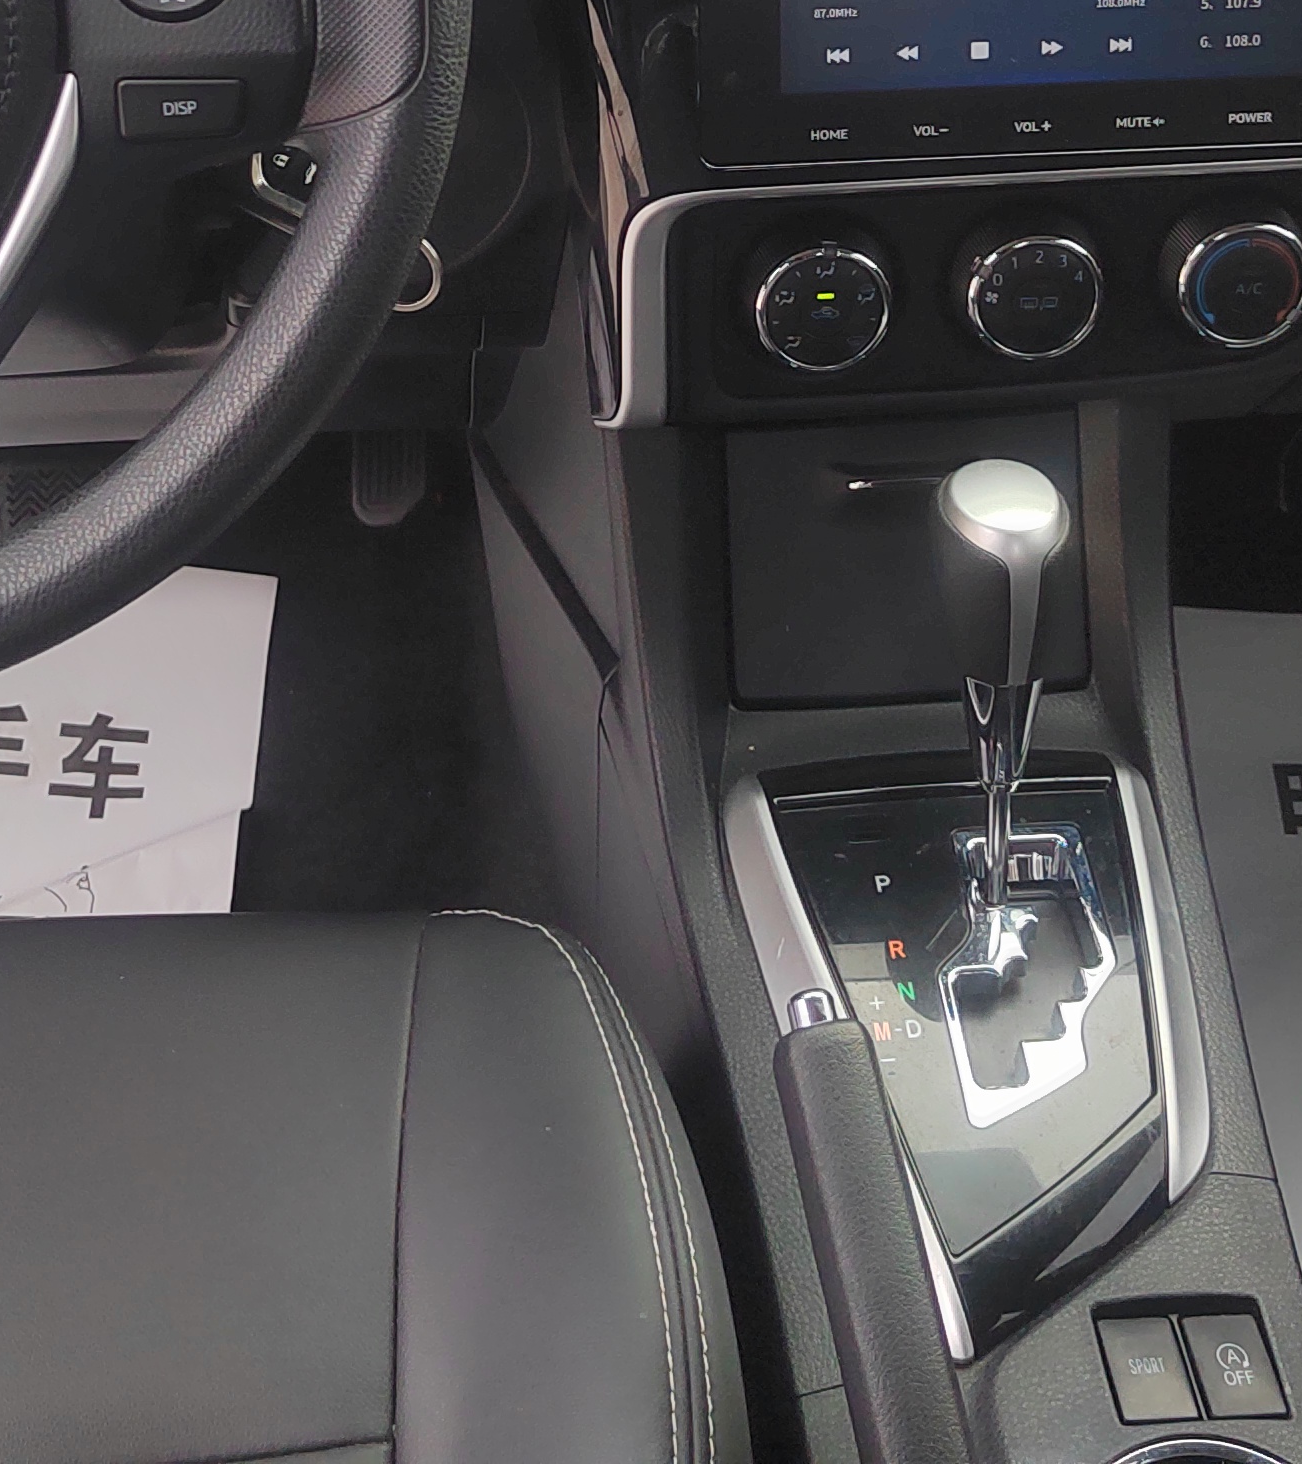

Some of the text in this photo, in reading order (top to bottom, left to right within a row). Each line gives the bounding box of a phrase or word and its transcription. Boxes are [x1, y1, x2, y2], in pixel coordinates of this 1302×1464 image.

[813, 6, 858, 20] 87.0MHz
[1225, 34, 1261, 48] 108.0
[162, 100, 198, 117] DISP
[1115, 115, 1152, 129] MUTE
[1228, 111, 1273, 125] POWER
[810, 127, 849, 142] HOME
[1011, 256, 1019, 270] 1
[1035, 250, 1045, 265] 2
[1059, 253, 1069, 268] 3
[993, 273, 1003, 287] 0
[1074, 270, 1084, 284] 4
[1235, 281, 1264, 297] A/C
[874, 874, 891, 893] P
[888, 940, 906, 960] R
[897, 981, 916, 1001] N
[1128, 1357, 1166, 1376] SPORT
[1223, 1370, 1254, 1386] OFF
